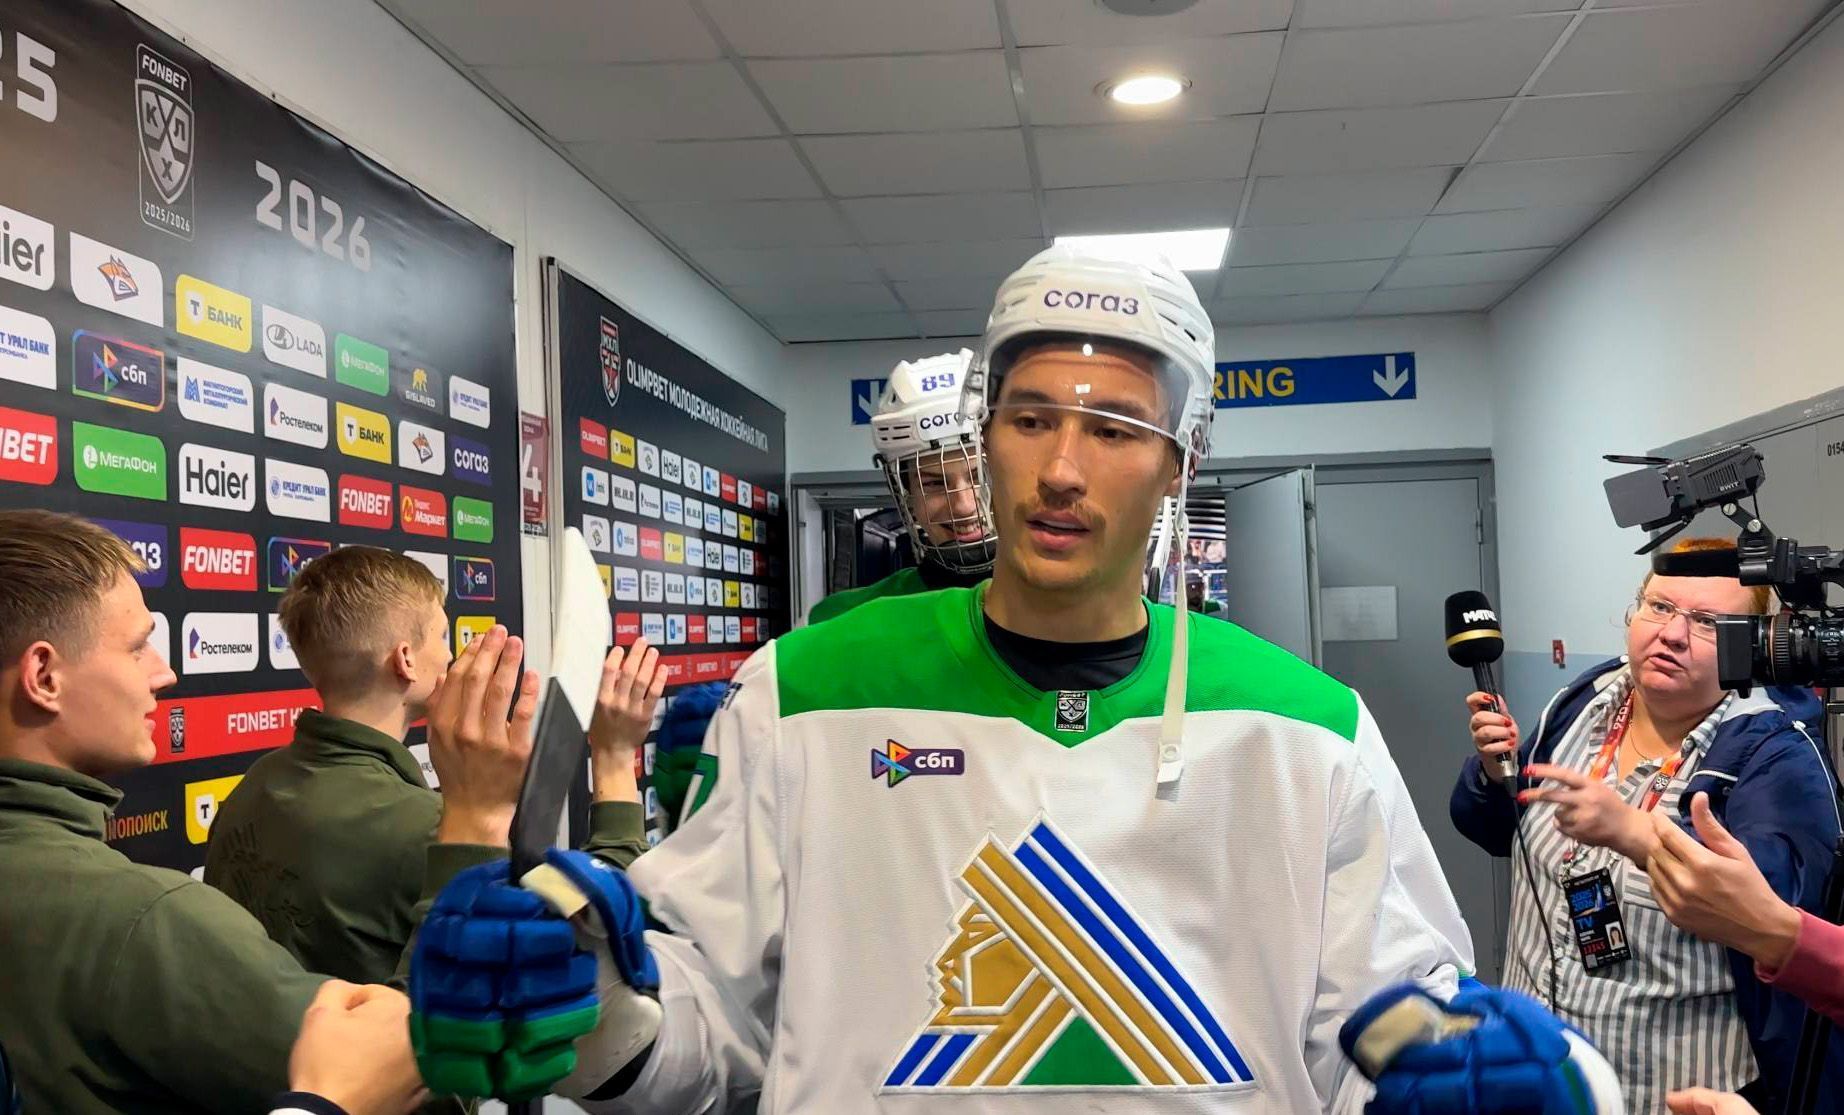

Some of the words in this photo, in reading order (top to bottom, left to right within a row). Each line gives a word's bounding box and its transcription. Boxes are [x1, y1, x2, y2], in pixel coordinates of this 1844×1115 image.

[0, 30, 57, 123] 5
[142, 54, 188, 92] FONBET
[144, 200, 191, 233] 2025/2026
[255, 160, 371, 272] 2026
[0, 220, 45, 277] ier
[207, 305, 243, 331] БАНК
[296, 336, 324, 359] LADA
[121, 364, 147, 386] сбп
[626, 358, 669, 403] OLIMPBET
[921, 373, 956, 392] 89
[280, 411, 324, 434] Ростелеком
[920, 412, 974, 429] сог
[0, 427, 53, 465] BET
[359, 427, 385, 445] БАНК
[186, 456, 249, 500] Haier
[521, 443, 542, 502] 4
[340, 488, 391, 516] FONBET
[184, 545, 254, 575] FONBET
[201, 640, 253, 656] Ростелеком
[228, 709, 287, 734] FONBET
[915, 752, 955, 769] сбп
